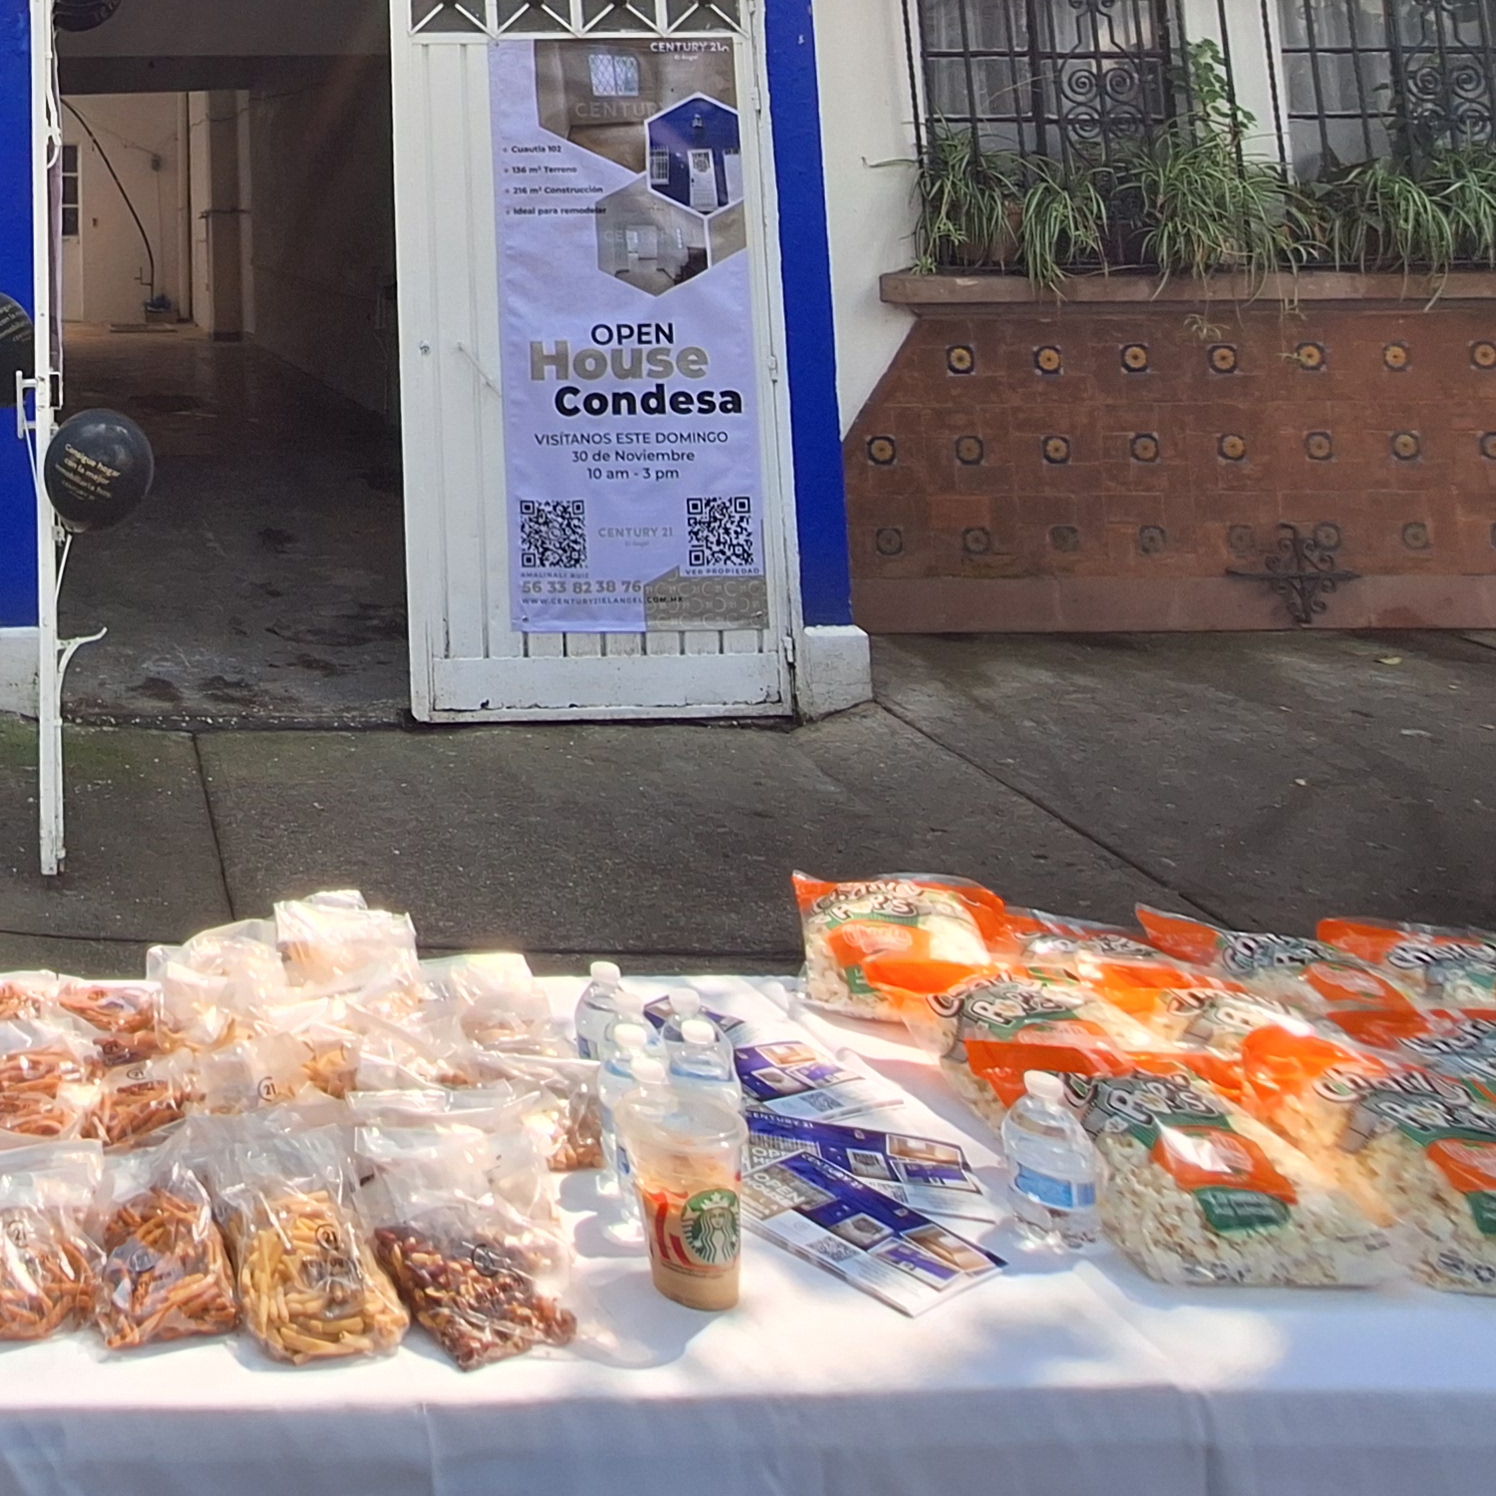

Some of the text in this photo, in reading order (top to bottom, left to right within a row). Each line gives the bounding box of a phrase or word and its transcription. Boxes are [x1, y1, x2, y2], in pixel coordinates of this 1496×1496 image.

[650, 41, 707, 52] CENTURY
[511, 145, 562, 153] Cuautla 102
[512, 166, 527, 174] 136
[544, 166, 577, 174] Terreno
[513, 187, 527, 195] 216
[544, 185, 603, 194] Construcción
[513, 207, 607, 216] Ideal para remodelar
[590, 322, 674, 346] OPEN
[529, 340, 709, 381] House
[554, 383, 743, 417] Condesa
[534, 431, 729, 446] VISÍTANOS ESTE DOMINGO
[572, 448, 695, 462] 30 de Noviembre
[587, 467, 602, 480] 10
[606, 470, 629, 480] am
[642, 467, 651, 480] 3
[655, 469, 679, 482] pm
[598, 527, 673, 538] CENTURY 21
[706, 567, 759, 575] PROPIEDAD
[522, 579, 642, 594] 56 33 82 38 76
[753, 1172, 805, 1204] OPEN
